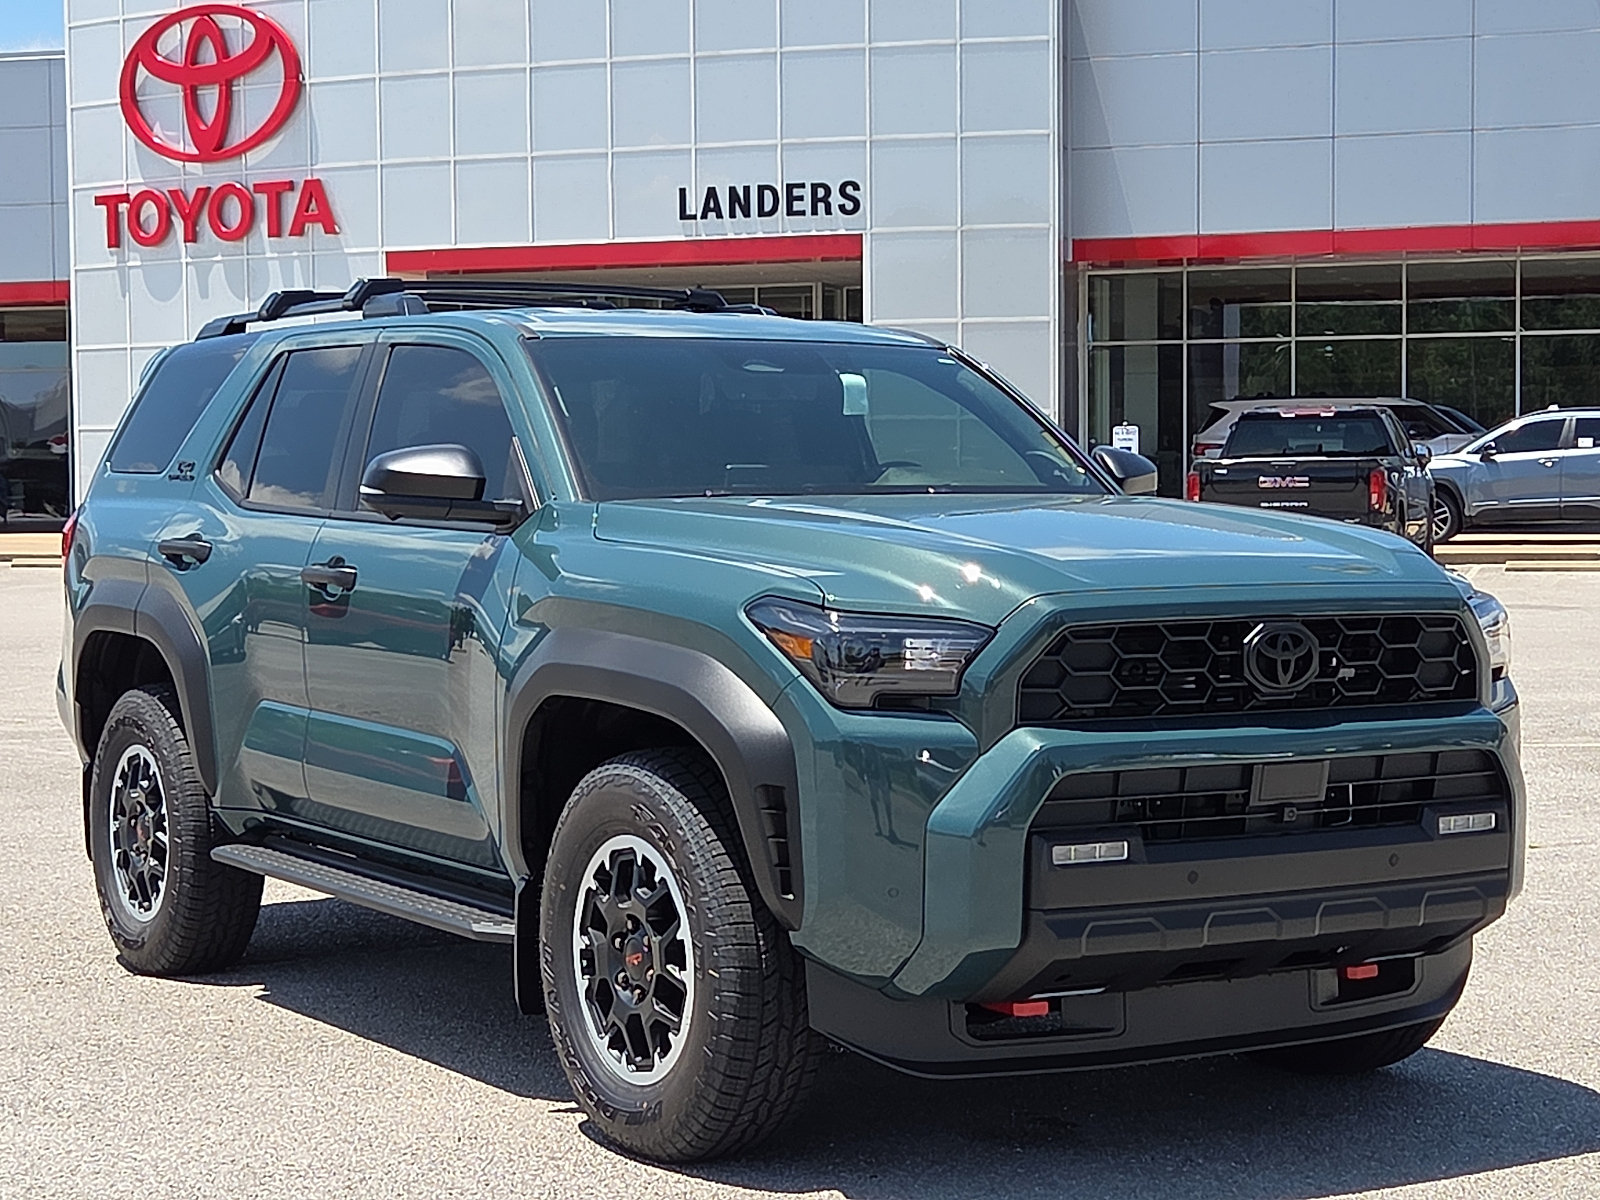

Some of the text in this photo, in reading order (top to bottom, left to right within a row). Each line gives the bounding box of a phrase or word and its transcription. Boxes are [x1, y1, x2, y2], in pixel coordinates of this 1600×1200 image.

[94, 178, 340, 249] TOYOTA
[679, 180, 861, 220] LANDERS
[1258, 475, 1310, 488] GMC
